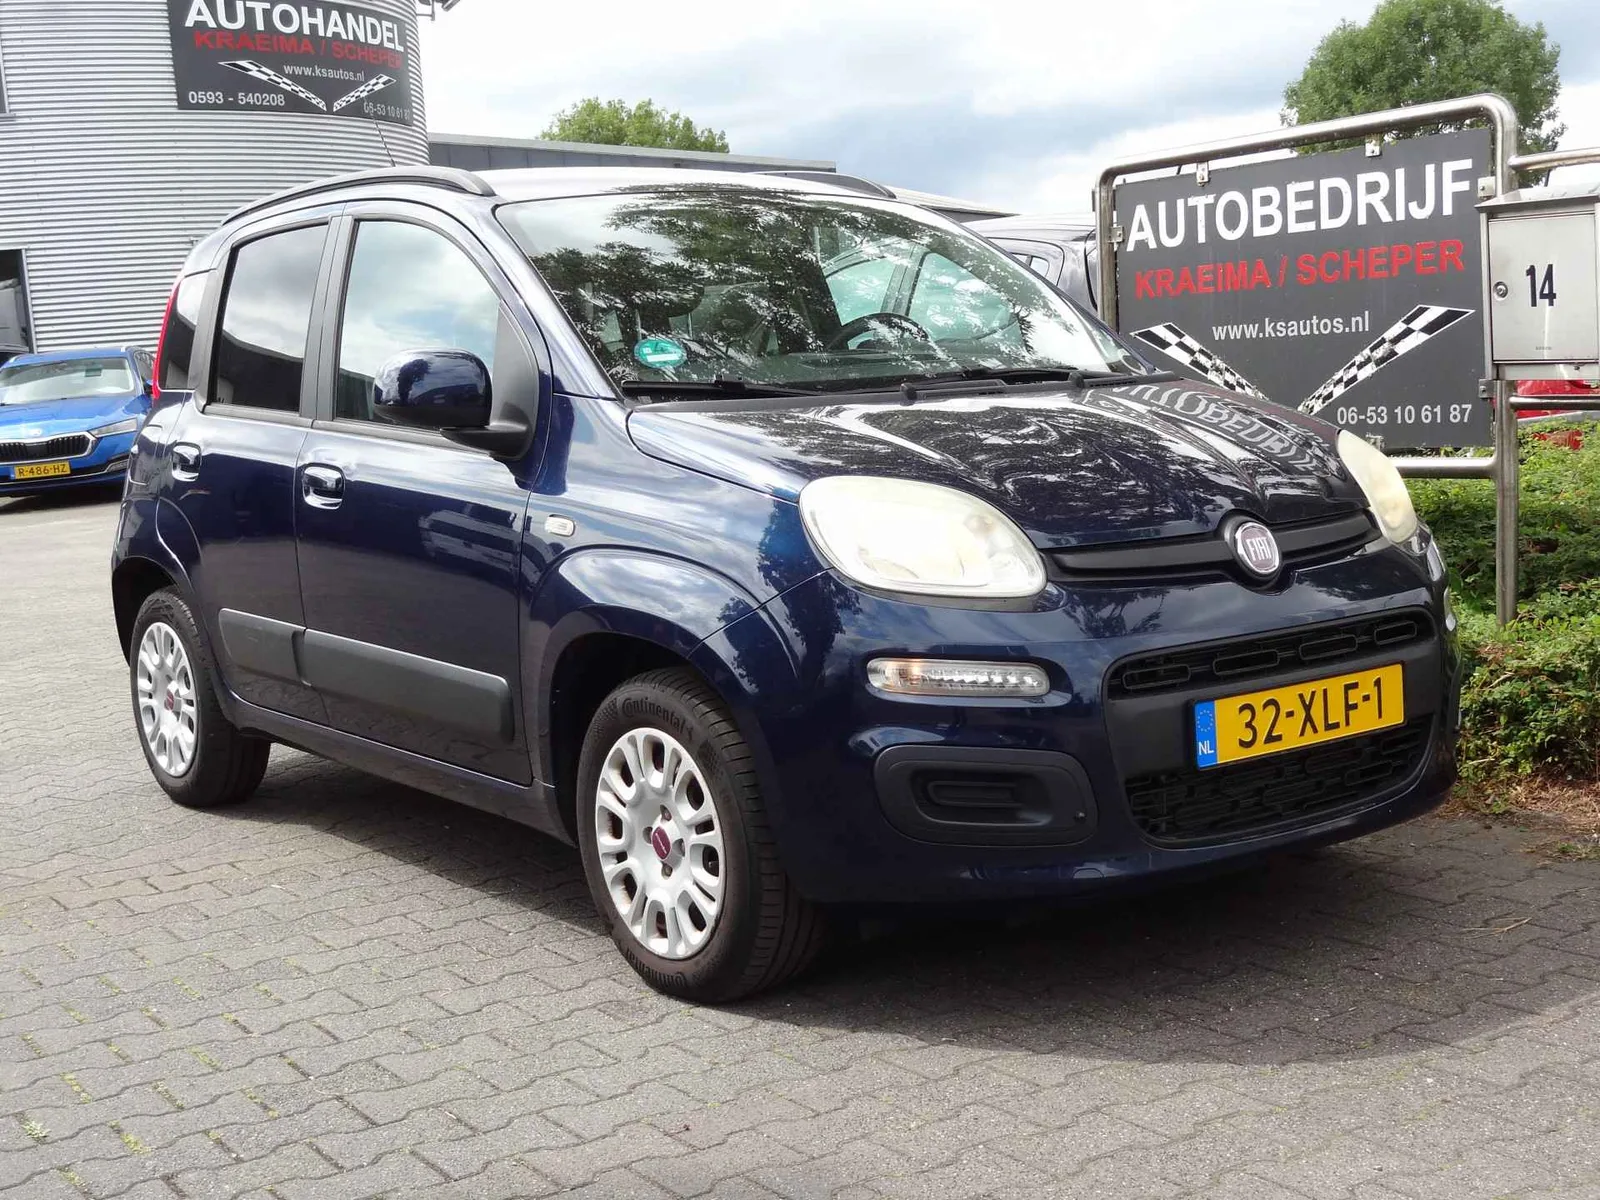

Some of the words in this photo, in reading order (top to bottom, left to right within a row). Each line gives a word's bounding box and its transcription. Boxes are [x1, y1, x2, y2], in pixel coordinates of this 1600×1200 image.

[184, 0, 404, 52] AUTOHANDEL
[331, 42, 402, 69] SCHEPER
[283, 64, 365, 82] www.ksautos.nl
[188, 91, 224, 104] 0593
[238, 92, 286, 106] 540208
[1126, 158, 1473, 252] AUTOBEDRIJF
[1277, 255, 1289, 288] /
[1296, 239, 1465, 285] SCHEPER
[1526, 264, 1557, 307] 14
[1212, 310, 1370, 341] www.ksautos.nl
[1337, 406, 1388, 425] 06-53
[1394, 405, 1416, 424] 10
[1420, 404, 1443, 423] 61
[1449, 403, 1473, 423] 87
[18, 463, 68, 477] R-486-HZ
[1246, 536, 1272, 562] FIAT
[621, 697, 686, 733] Continental
[1237, 676, 1383, 749] 32-XLF-1
[1198, 740, 1215, 755] NL
